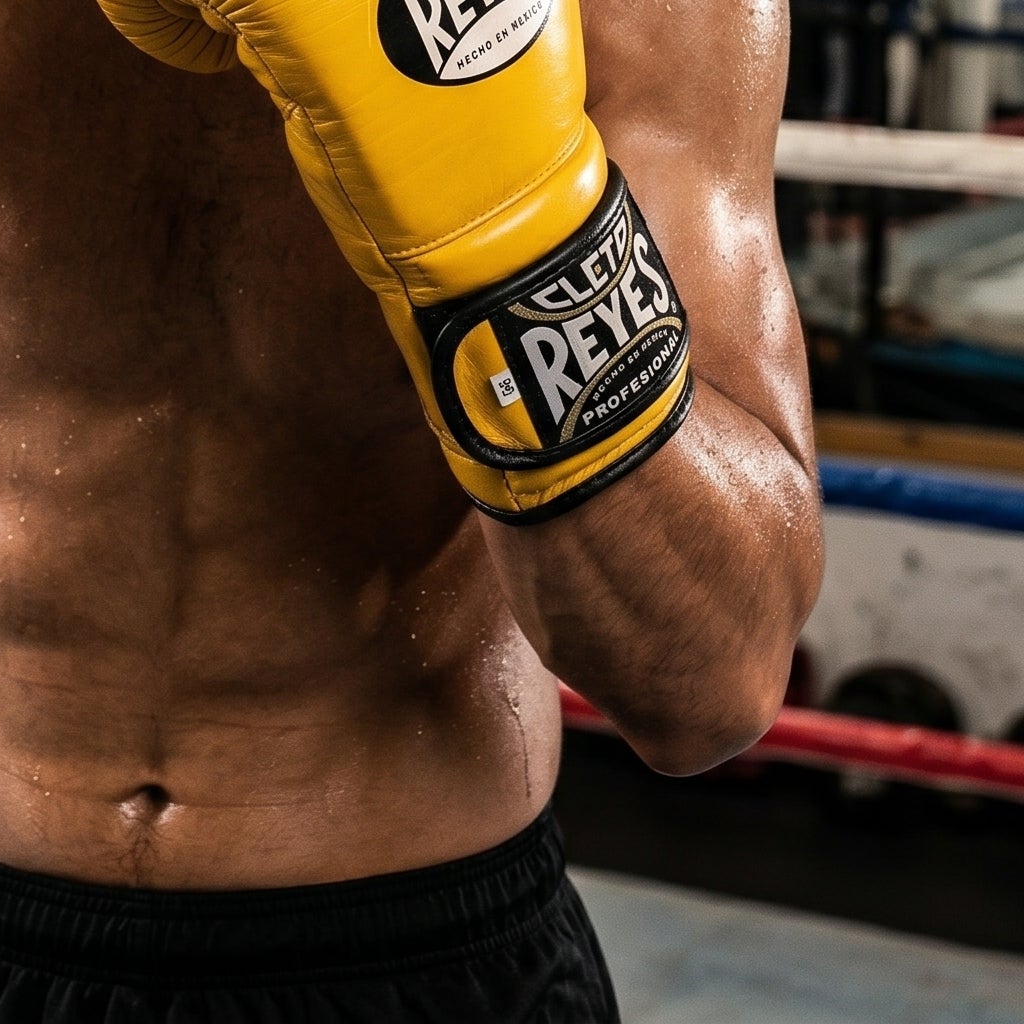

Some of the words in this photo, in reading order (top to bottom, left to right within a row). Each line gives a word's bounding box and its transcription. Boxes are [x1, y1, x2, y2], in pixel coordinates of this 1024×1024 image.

[456, 40, 492, 70] HECHO
[495, 28, 509, 43] EN
[520, 232, 669, 425] REYES
[582, 330, 679, 426] PROFESIONAL
